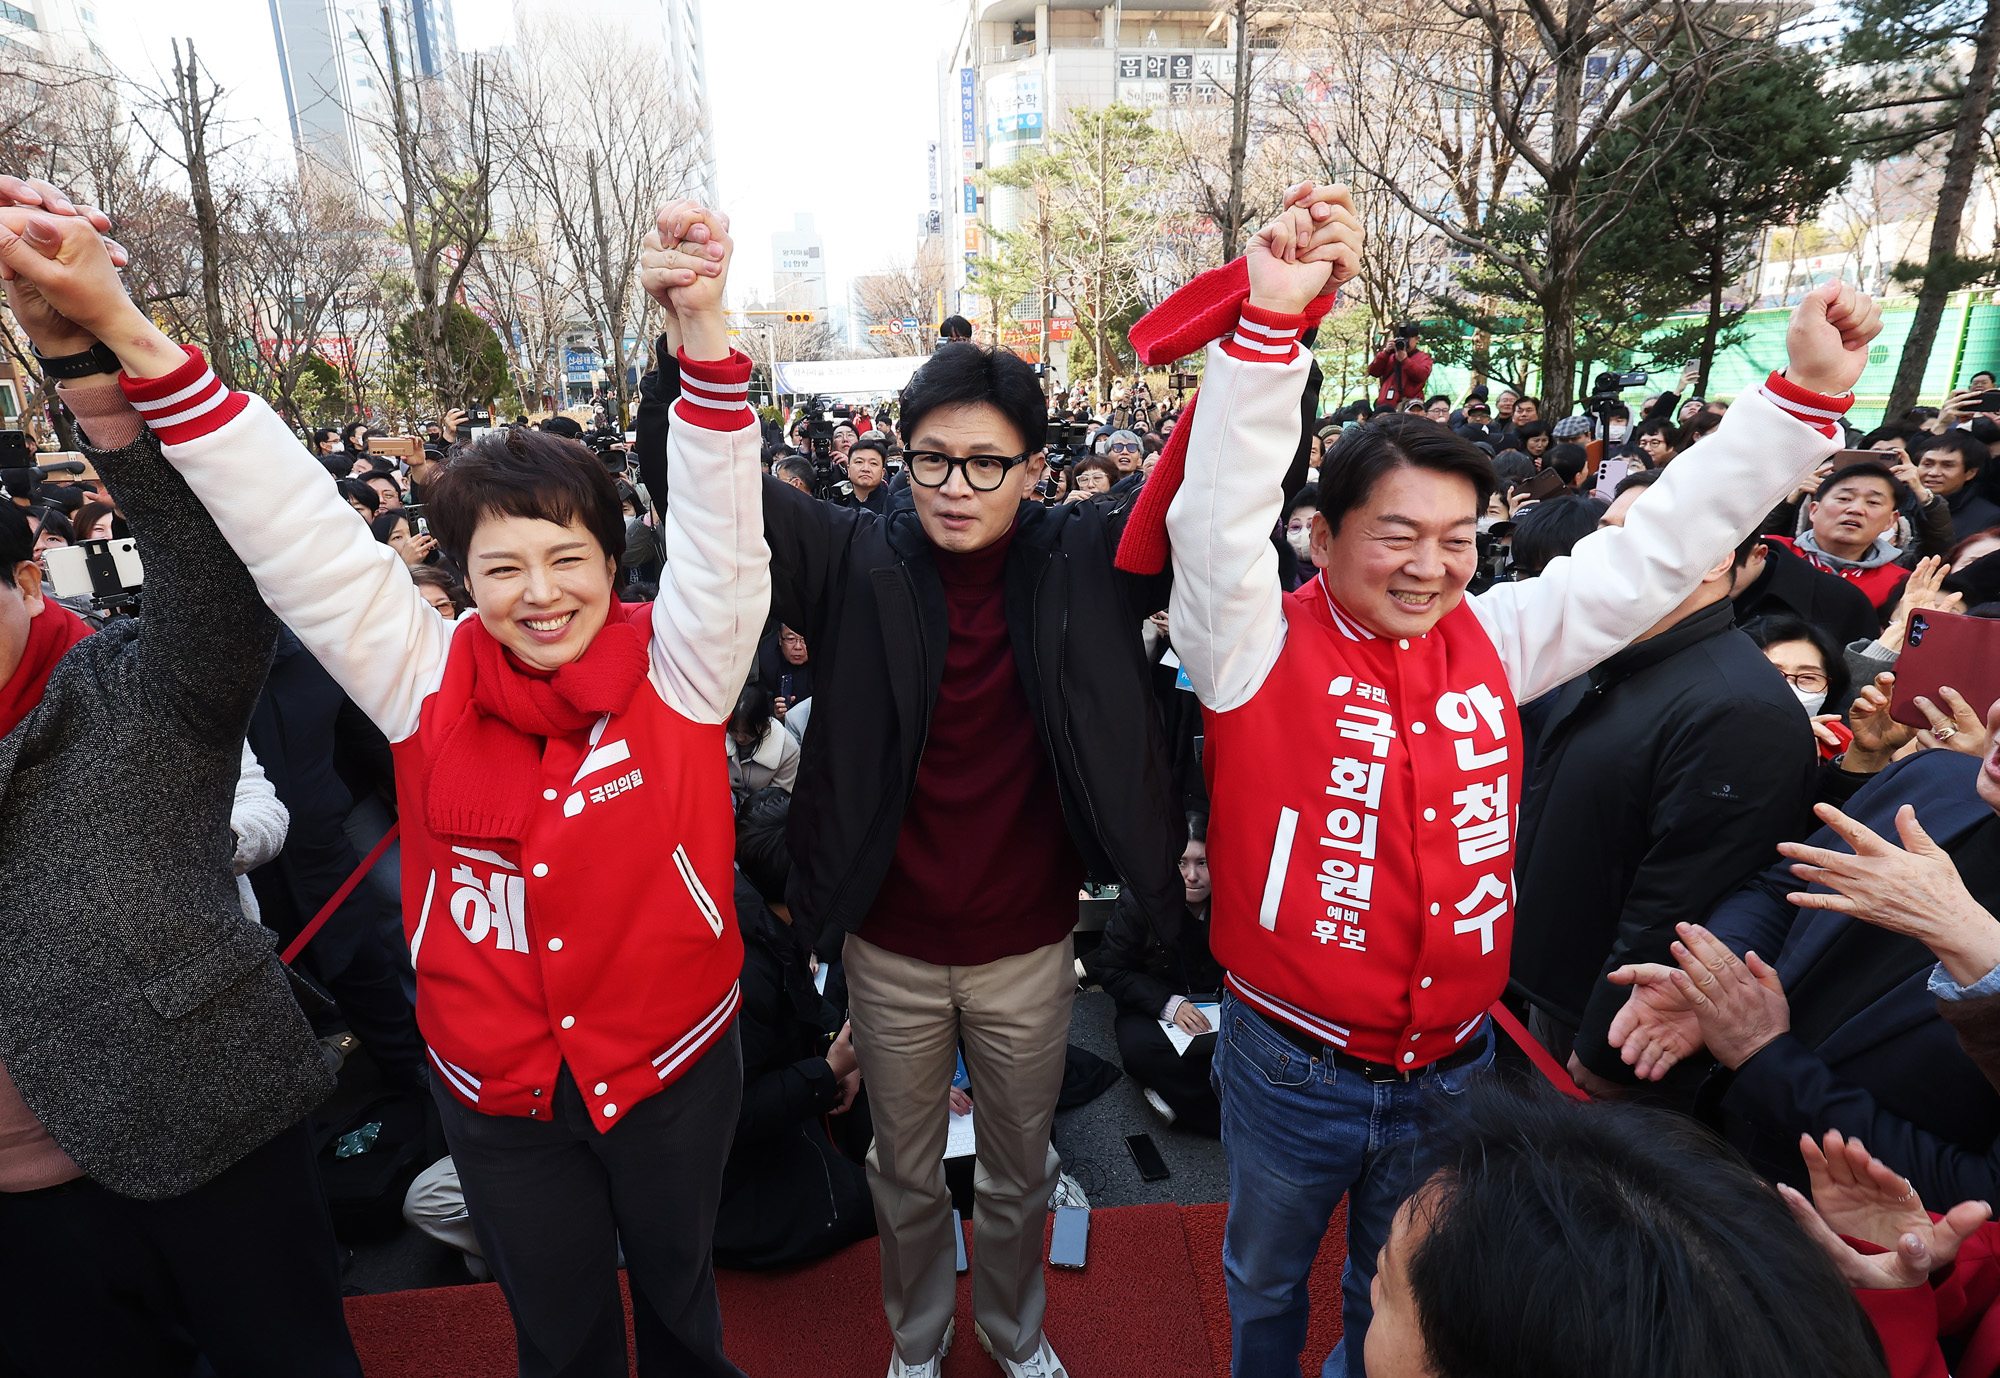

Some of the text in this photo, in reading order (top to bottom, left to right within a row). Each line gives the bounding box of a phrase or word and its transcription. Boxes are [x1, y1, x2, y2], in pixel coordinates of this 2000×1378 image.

[1122, 56, 1190, 78] 음악을
[962, 86, 972, 122] 예영어
[1356, 682, 1390, 705] 국민
[589, 768, 644, 804] 국민의힘
[1315, 704, 1397, 911] 국회의원
[1435, 682, 1509, 956] 안철수
[1326, 905, 1359, 925] 예비
[1311, 919, 1367, 952] 후보
